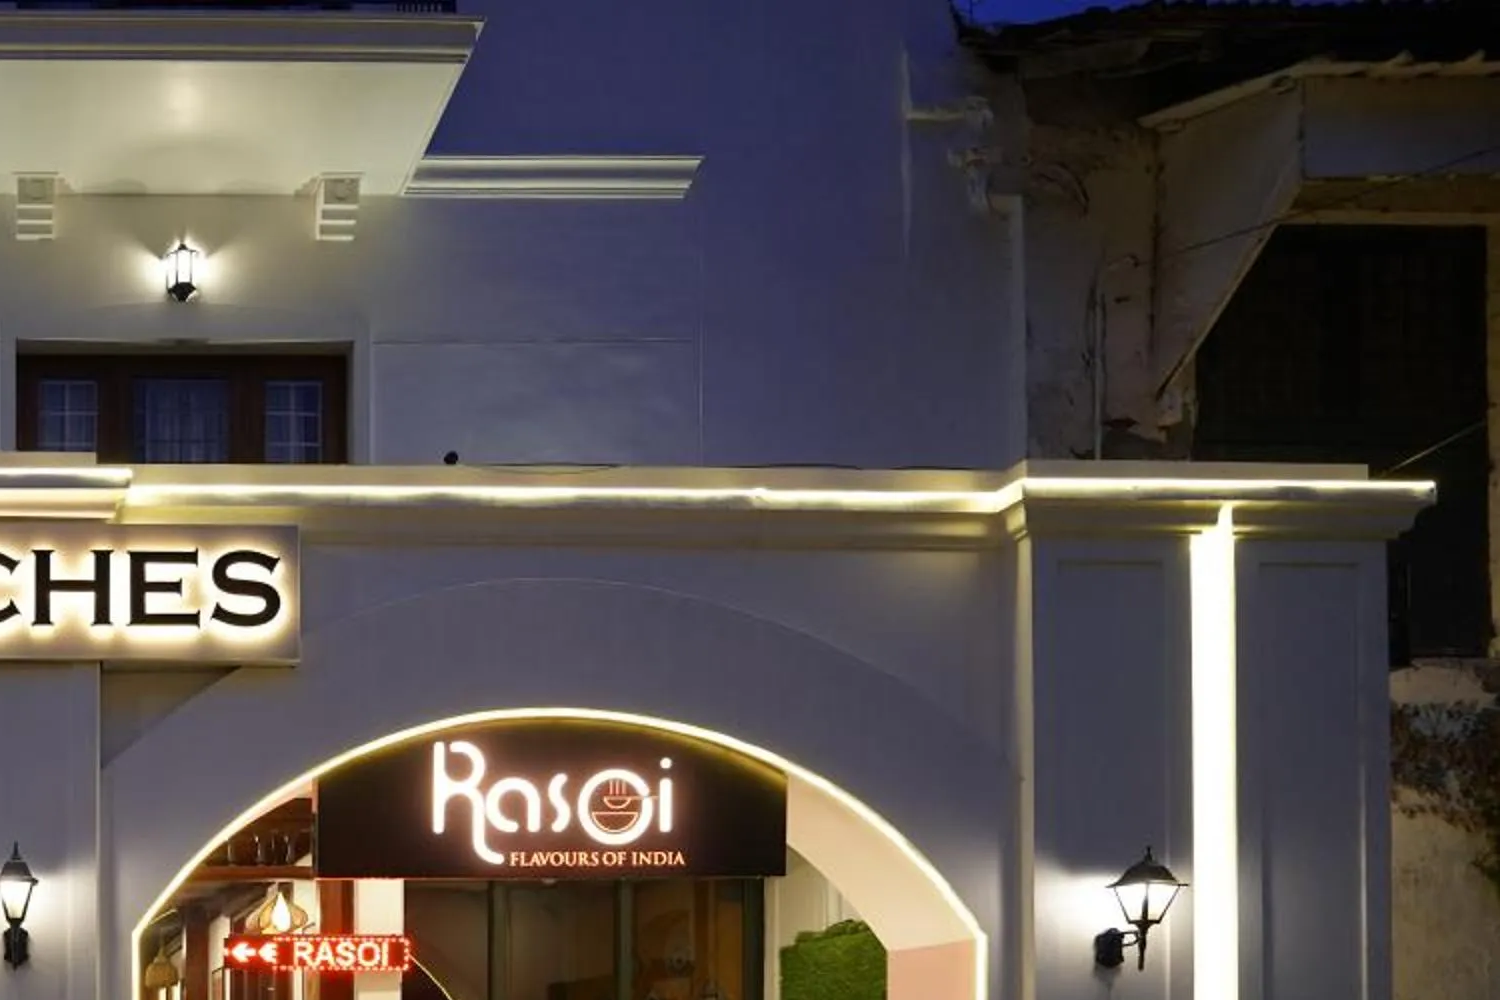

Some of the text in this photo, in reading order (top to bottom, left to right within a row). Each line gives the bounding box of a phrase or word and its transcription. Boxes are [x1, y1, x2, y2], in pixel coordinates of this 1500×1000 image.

[509, 850, 687, 868] FLAVOURS OF INDIA
[292, 940, 390, 968] RASOI
